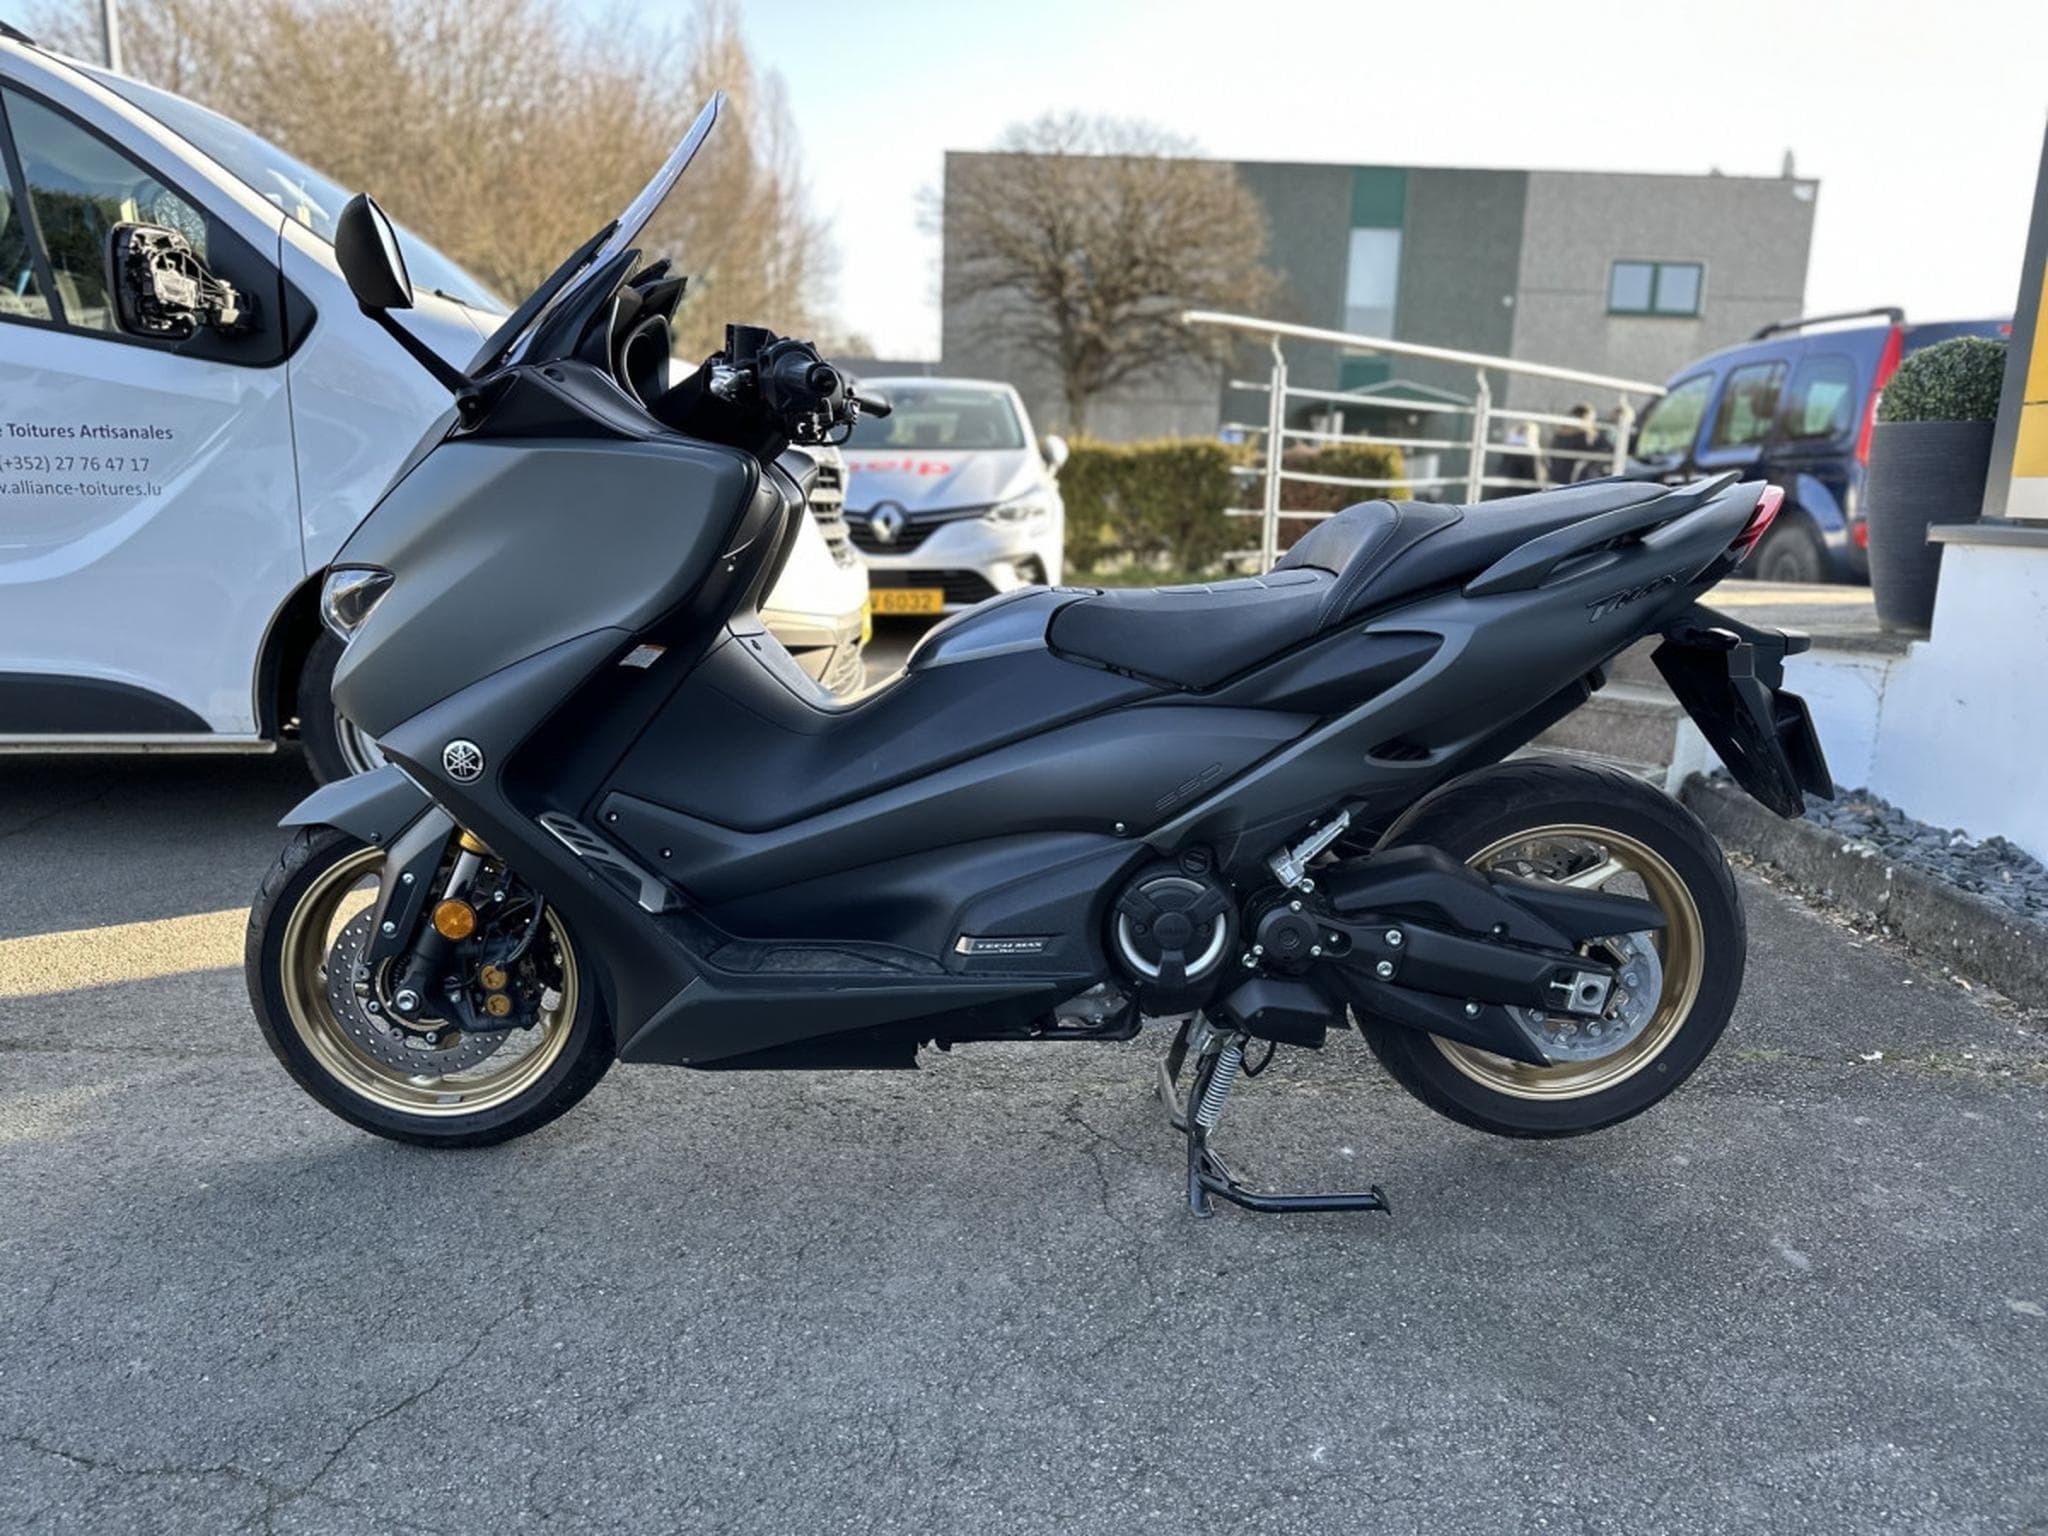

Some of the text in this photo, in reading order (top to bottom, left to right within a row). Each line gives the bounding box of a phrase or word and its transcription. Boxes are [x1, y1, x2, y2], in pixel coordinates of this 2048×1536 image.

[6, 423, 75, 438] Toitures
[80, 424, 173, 440] Artisanales
[56, 456, 74, 470] 27
[80, 456, 101, 471] 76
[105, 457, 124, 471] 47
[131, 457, 150, 472] 17
